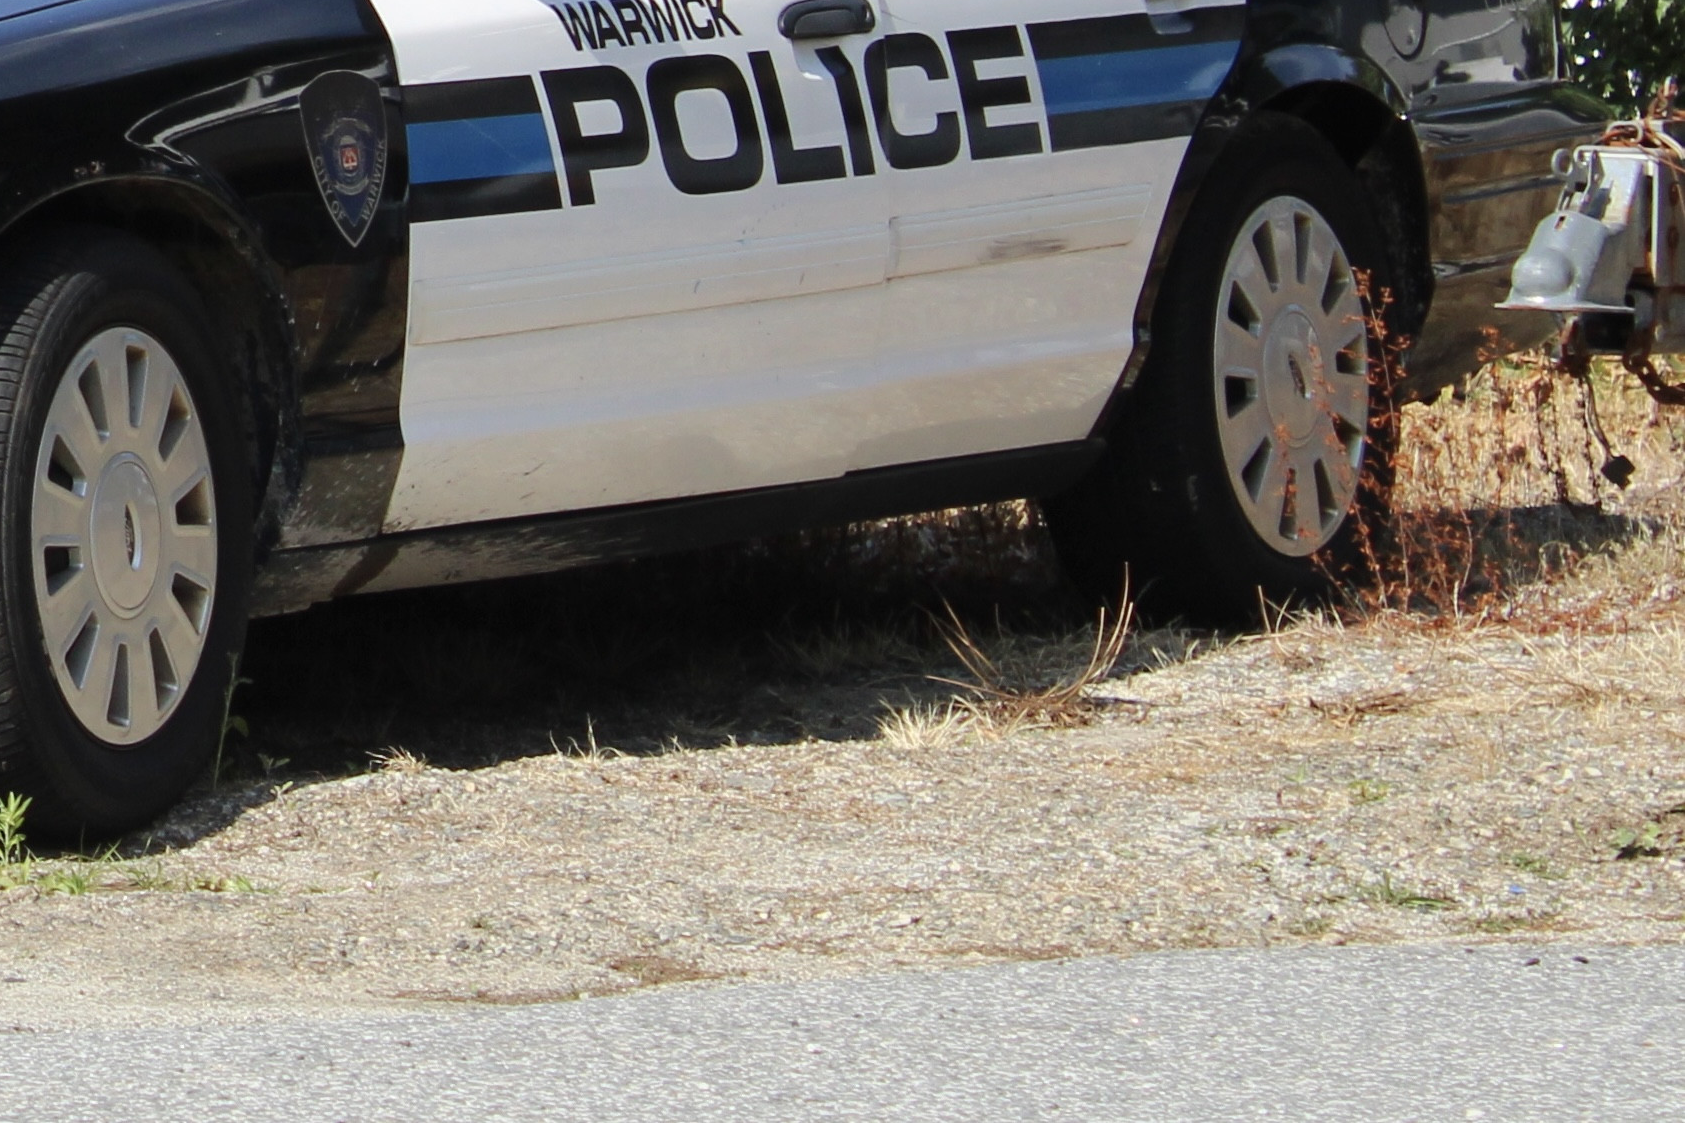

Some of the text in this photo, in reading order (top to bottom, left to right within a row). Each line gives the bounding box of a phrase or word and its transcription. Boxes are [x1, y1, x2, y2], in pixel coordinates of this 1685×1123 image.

[314, 156, 333, 195] CITY
[330, 200, 348, 221] OF
[361, 138, 387, 221] WARWICK
[540, 24, 1044, 207] POLICE
